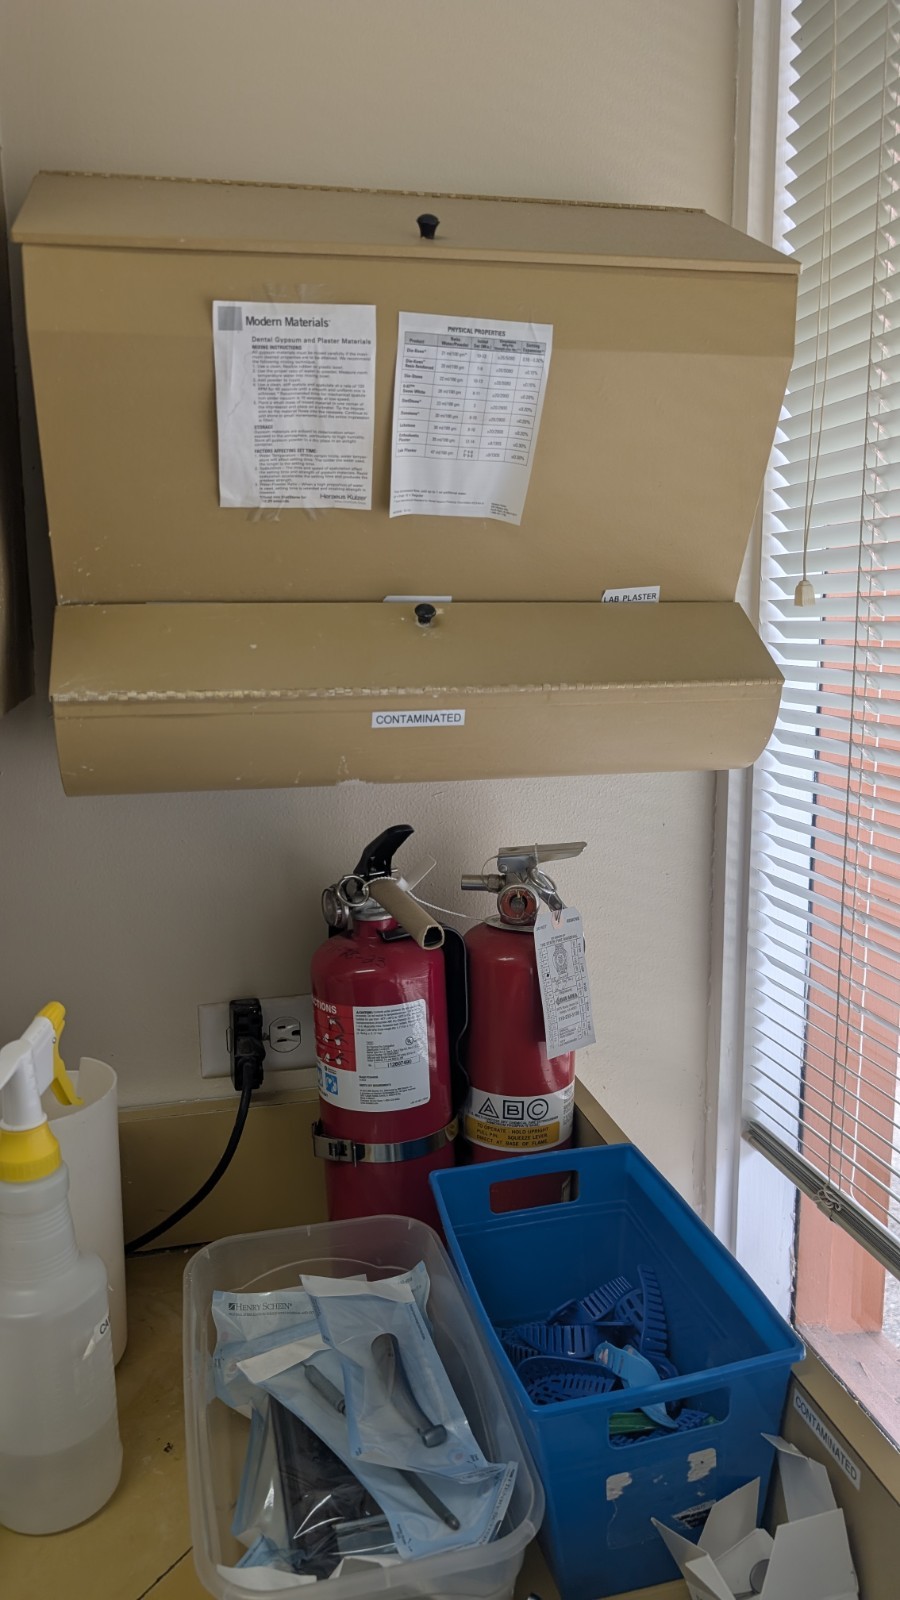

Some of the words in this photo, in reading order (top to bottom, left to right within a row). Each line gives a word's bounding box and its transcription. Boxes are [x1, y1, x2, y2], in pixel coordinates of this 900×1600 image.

[246, 316, 282, 327] Modern
[447, 326, 473, 334] PHYSICAL
[474, 328, 506, 337] PROPERTIES
[274, 337, 302, 345] Gypsum
[603, 595, 620, 603] LAB
[622, 592, 657, 602] PLASTER
[375, 712, 462, 725] CONTAMINATED
[476, 1129, 488, 1137] PULL
[483, 1125, 506, 1134] OPERATE
[476, 1134, 493, 1143] DIRECT
[235, 1302, 261, 1311] HENRY
[795, 1396, 858, 1481] CONTAMINATED
